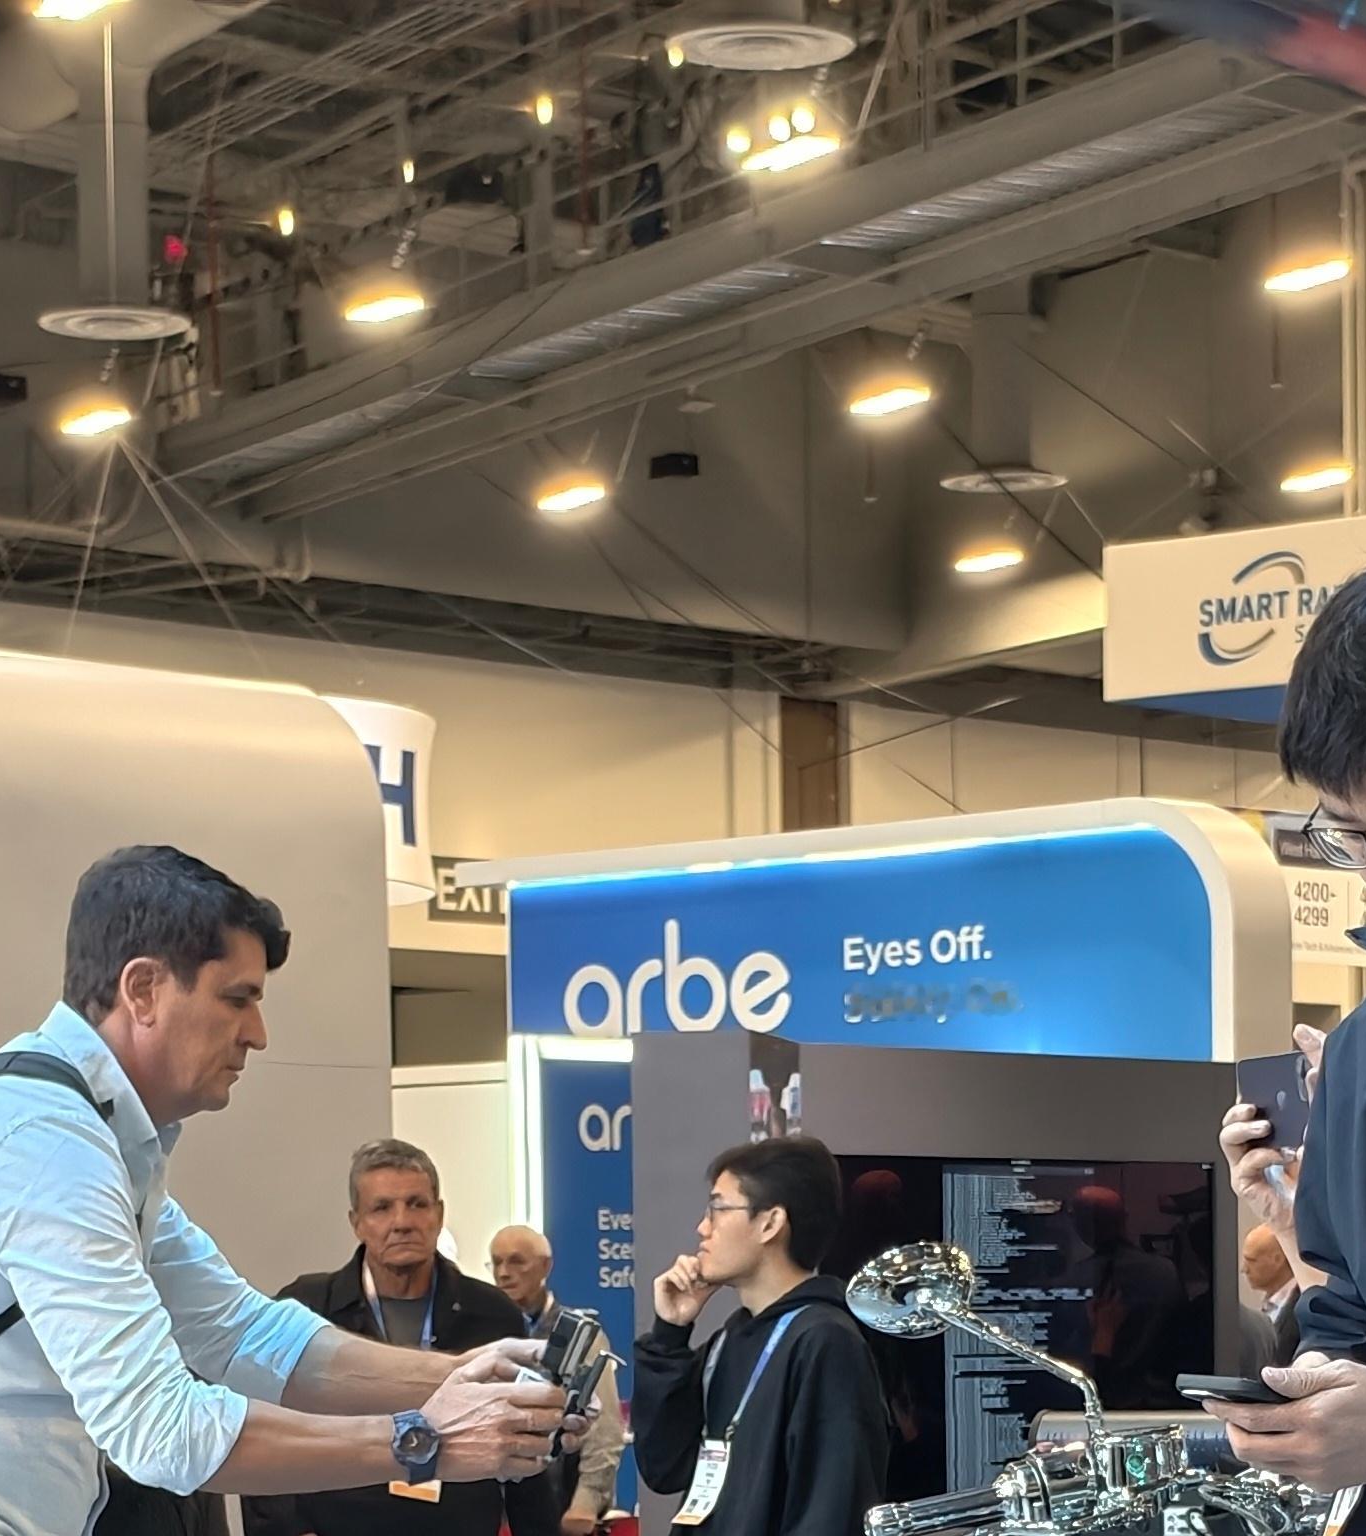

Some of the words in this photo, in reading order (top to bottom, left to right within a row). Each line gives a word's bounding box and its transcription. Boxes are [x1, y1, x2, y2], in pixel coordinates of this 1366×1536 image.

[1199, 590, 1290, 627] SMART
[1297, 585, 1341, 617] RA
[1294, 905, 1329, 927] 4299
[843, 934, 922, 975] Eyes
[930, 925, 994, 965] Off.
[563, 918, 791, 1037] arbe
[578, 1104, 633, 1151] ar
[598, 1208, 633, 1231] Eve
[598, 1238, 634, 1260] Sce
